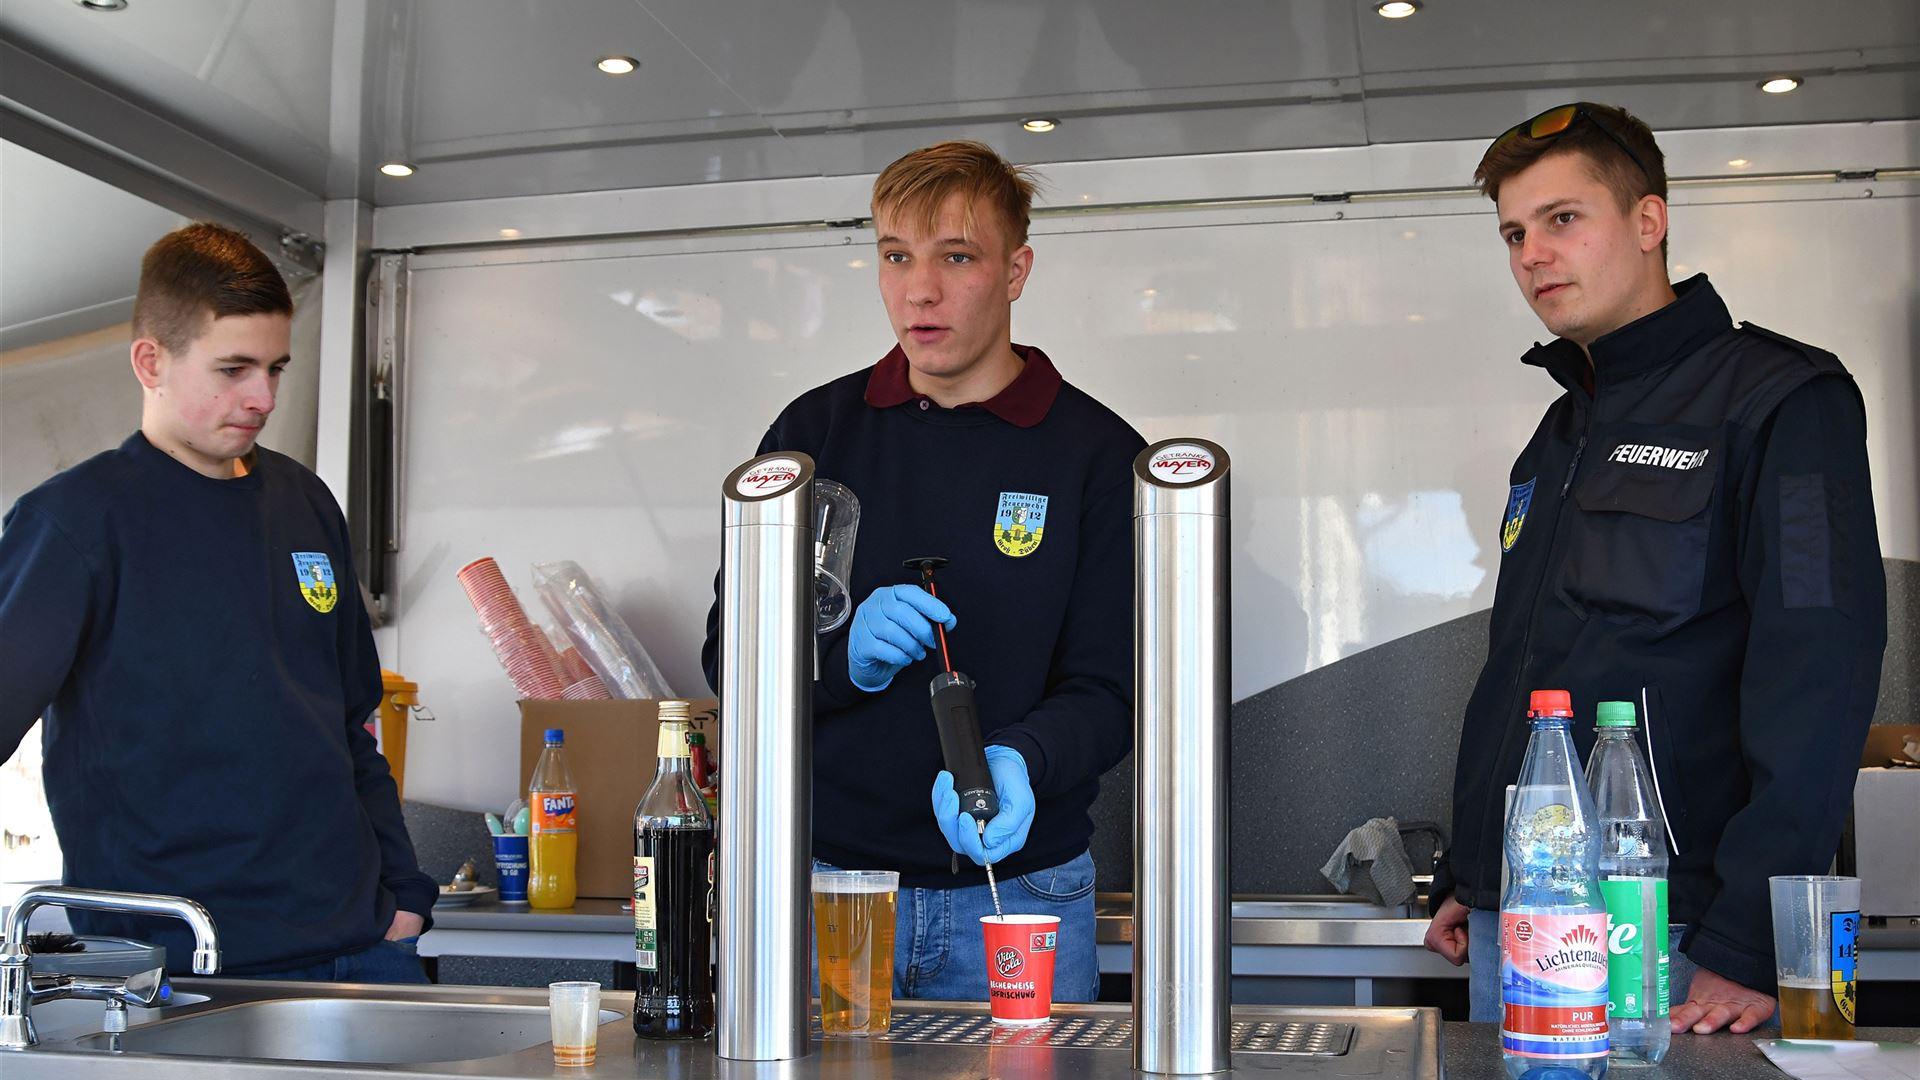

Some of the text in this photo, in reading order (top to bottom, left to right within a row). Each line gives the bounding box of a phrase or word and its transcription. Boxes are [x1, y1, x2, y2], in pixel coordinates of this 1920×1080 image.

[1607, 444, 1709, 470] FEUERWEHR
[1153, 459, 1211, 474] MAYER
[742, 473, 796, 488] MAYER
[1029, 512, 1041, 520] 12
[997, 951, 1016, 965] Vita
[999, 958, 1022, 974] Cola
[1572, 1011, 1594, 1022] PUR
